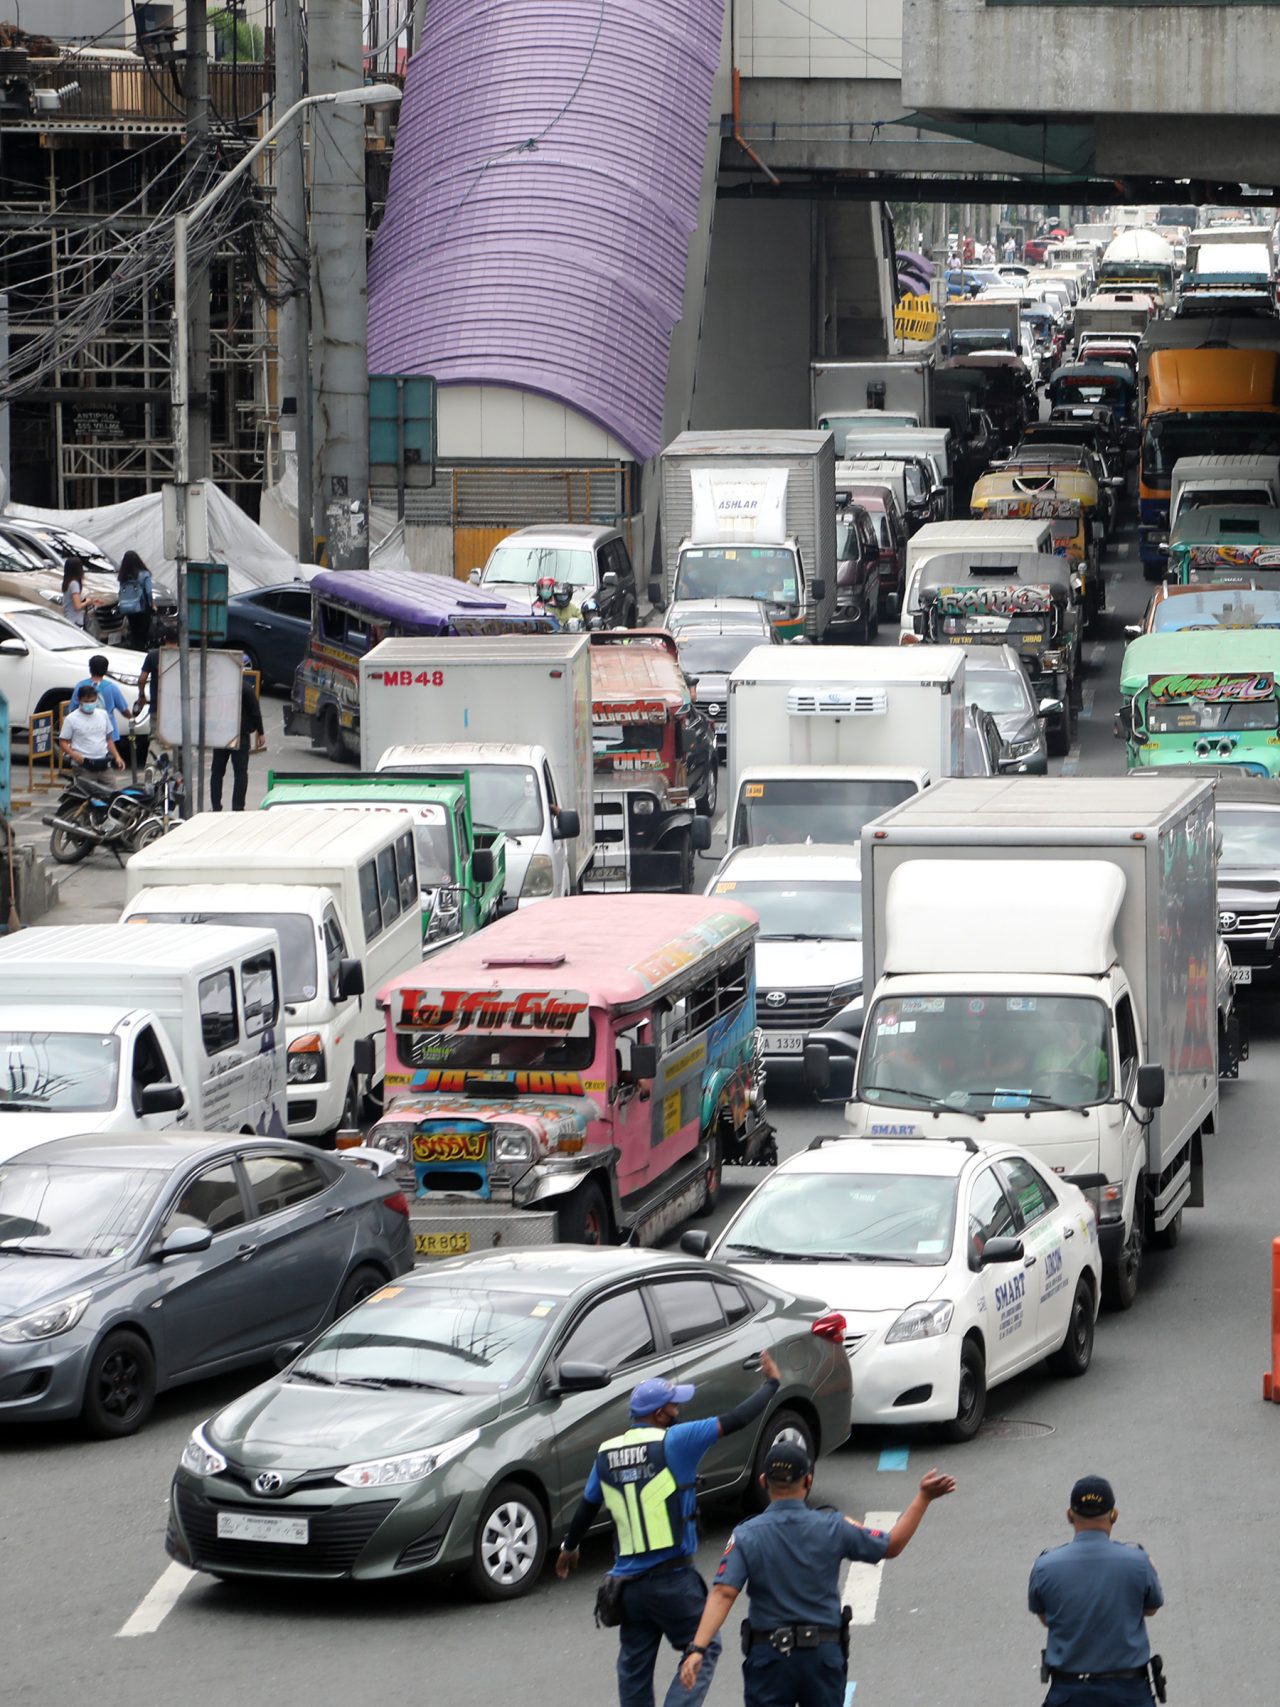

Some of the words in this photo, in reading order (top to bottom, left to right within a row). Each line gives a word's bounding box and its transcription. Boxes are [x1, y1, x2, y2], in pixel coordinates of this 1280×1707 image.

[718, 500, 758, 510] ASHLAR
[383, 670, 444, 687] MB48
[1232, 970, 1250, 981] 223
[776, 1039, 801, 1049] 1339
[871, 1124, 917, 1136] SMART
[415, 1235, 437, 1248] XR
[994, 1271, 1026, 1312] SMART
[607, 1445, 648, 1470] TRAFFIC
